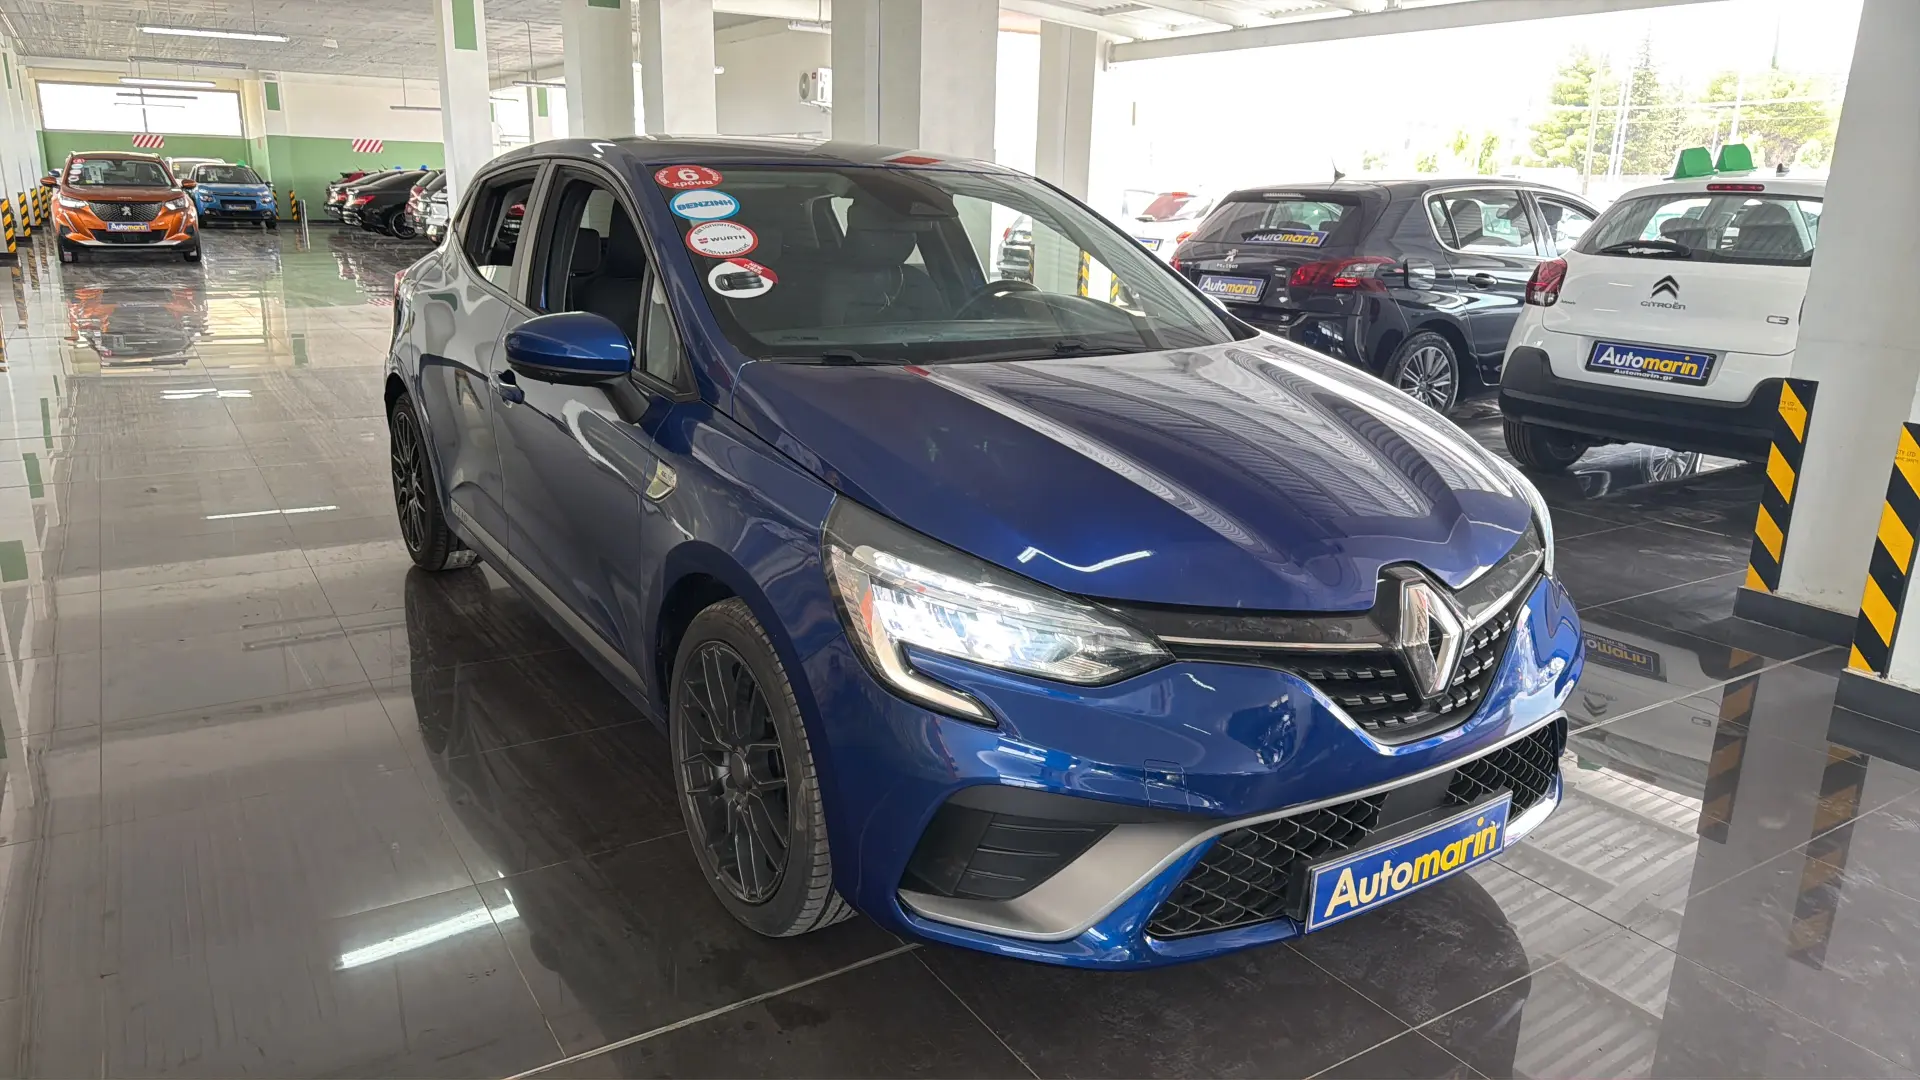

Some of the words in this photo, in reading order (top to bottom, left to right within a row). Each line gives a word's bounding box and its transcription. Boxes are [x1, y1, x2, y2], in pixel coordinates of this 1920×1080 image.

[677, 168, 700, 181] 6
[111, 222, 147, 230] Automarin
[1201, 277, 1257, 295] Automarin
[1766, 315, 1790, 325] C3
[1598, 346, 1699, 376] Automarin
[1613, 368, 1674, 381] Automarin.gr
[1324, 816, 1498, 918] Automarin
